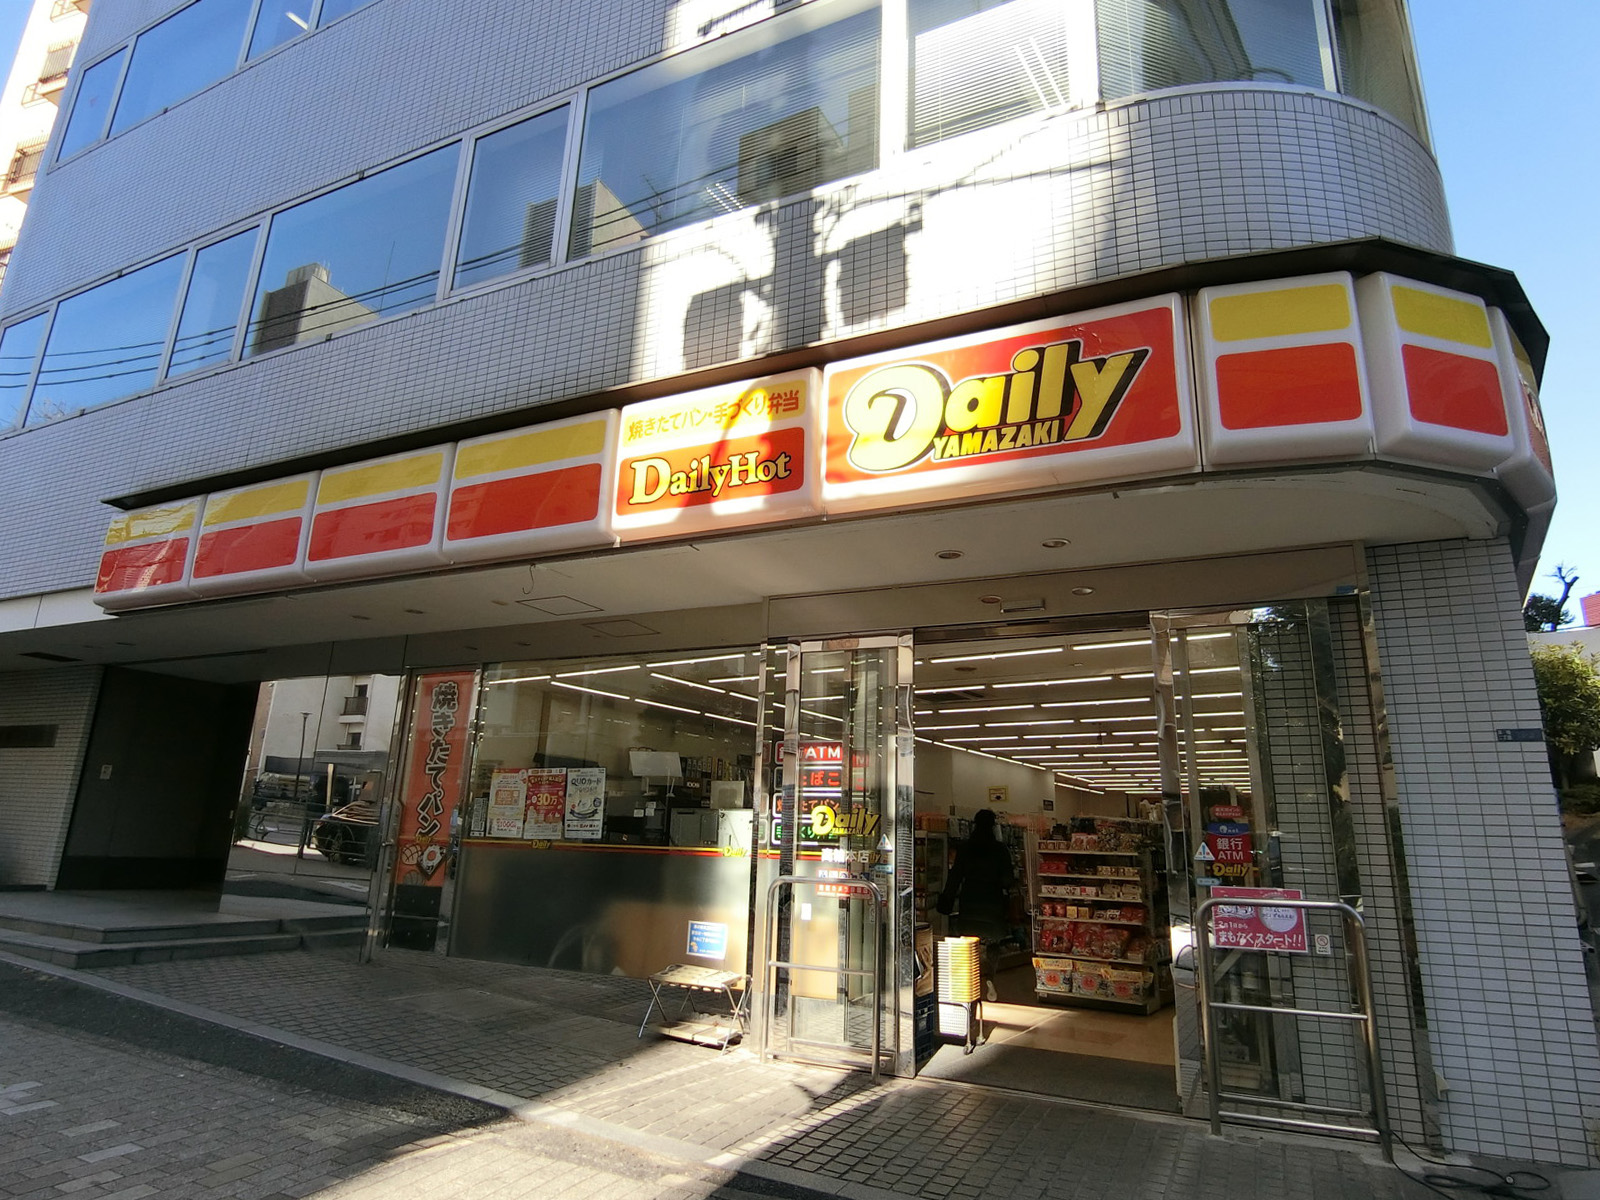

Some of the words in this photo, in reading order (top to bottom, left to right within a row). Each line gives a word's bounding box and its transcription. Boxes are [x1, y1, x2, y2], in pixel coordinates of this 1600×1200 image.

[628, 389, 800, 442] 焼きたてパン・手づくり弁当
[844, 341, 1151, 473] Daily
[933, 420, 1060, 460] YAMAZAKI
[417, 682, 458, 837] 焼きたてパン
[811, 805, 881, 836] Daily
[1217, 838, 1243, 850] 銀行
[1218, 851, 1243, 860] ATM
[1212, 863, 1249, 877] Daily
